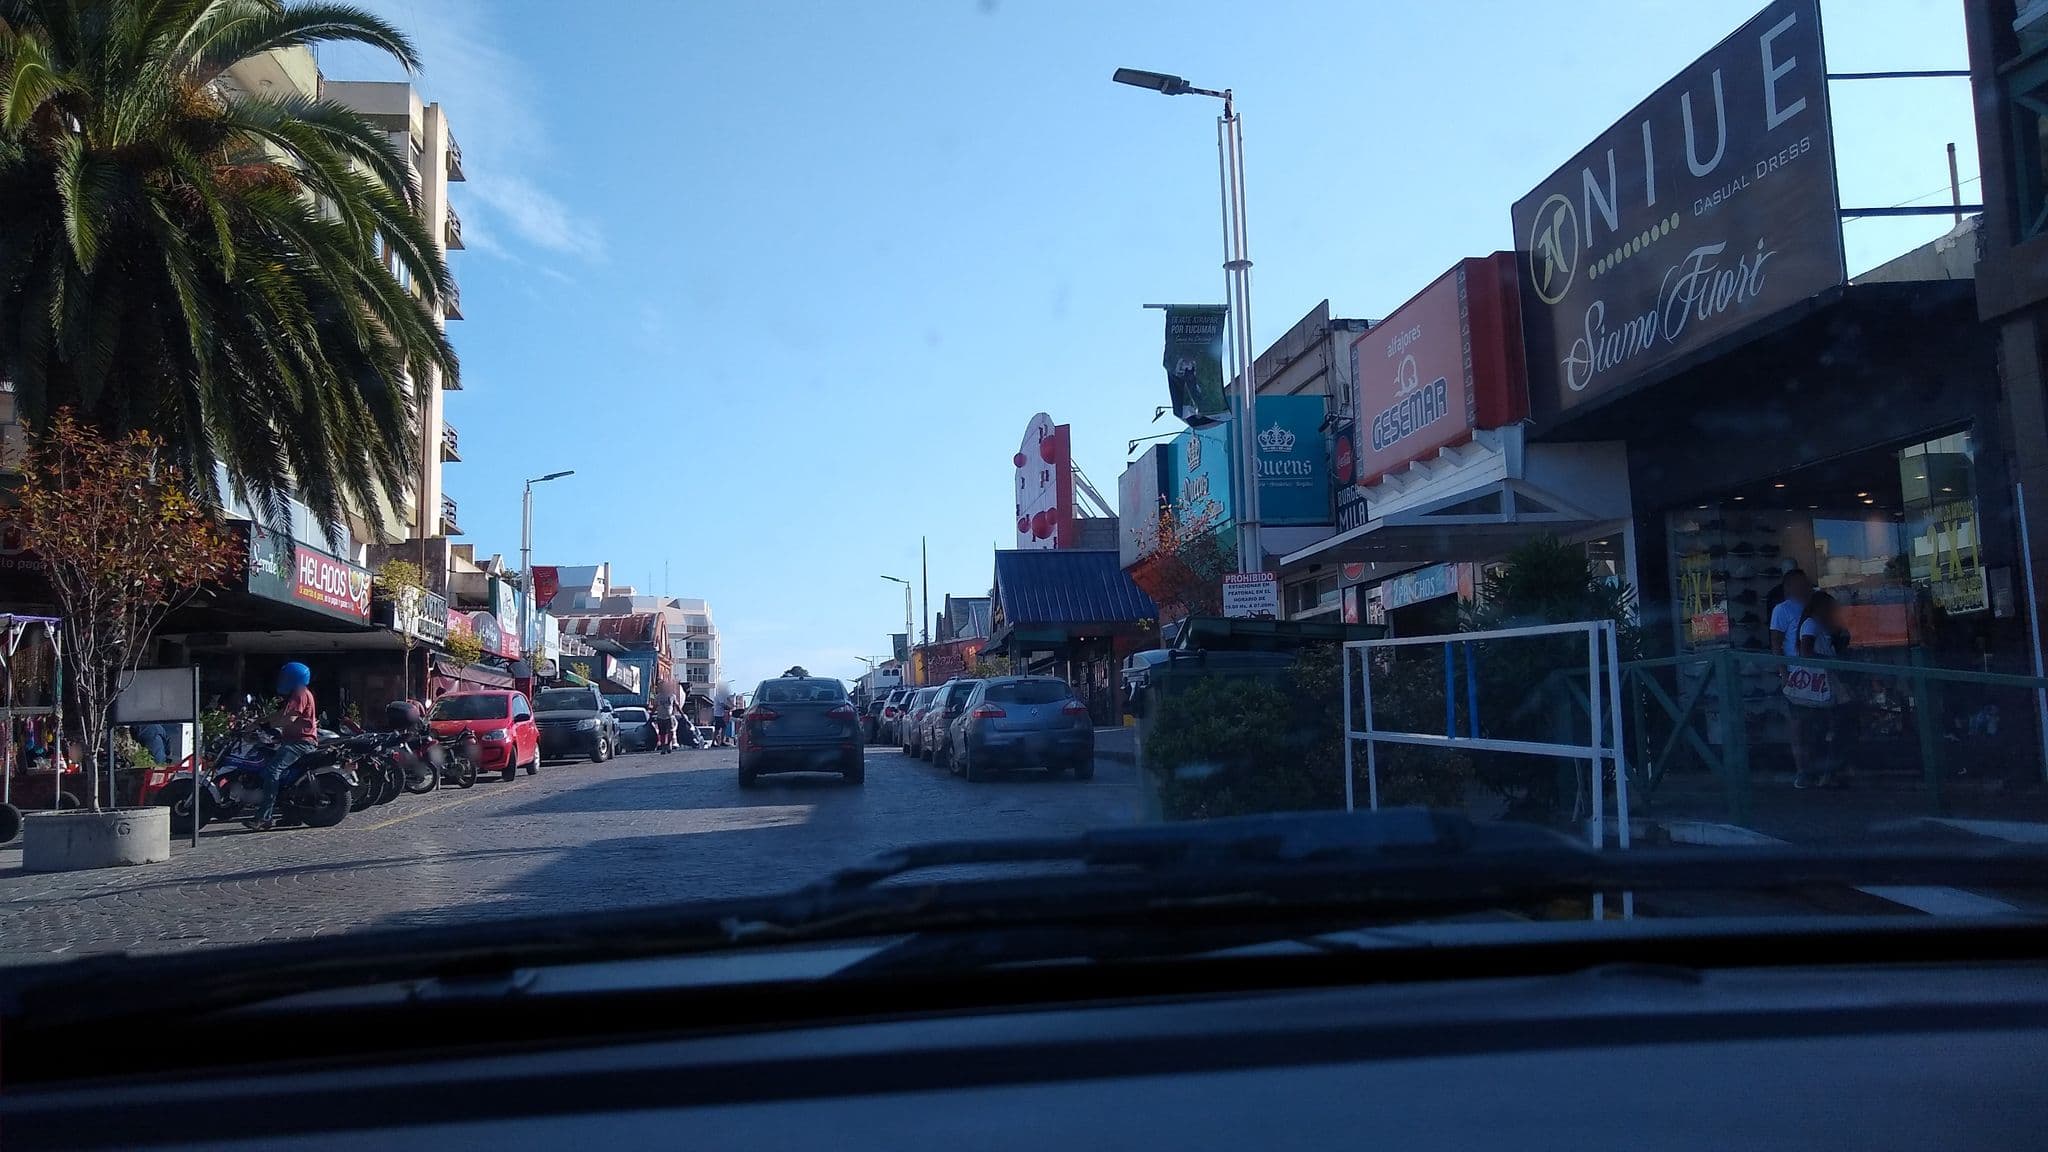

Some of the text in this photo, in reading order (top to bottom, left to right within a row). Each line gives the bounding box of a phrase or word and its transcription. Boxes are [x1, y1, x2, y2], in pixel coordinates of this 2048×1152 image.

[1582, 11, 1807, 248] NIUE
[1694, 136, 1811, 217] CASUAL DRESS
[1171, 325, 1184, 334] POR
[1561, 300, 1659, 392] Siamo
[1656, 237, 1777, 344] Fuori
[1386, 325, 1422, 358] alfajores
[1372, 376, 1449, 452] GESEMAR
[1338, 501, 1366, 533] MILA
[299, 553, 347, 598] HELADOS
[1226, 573, 1273, 583] PROHIBIDO
